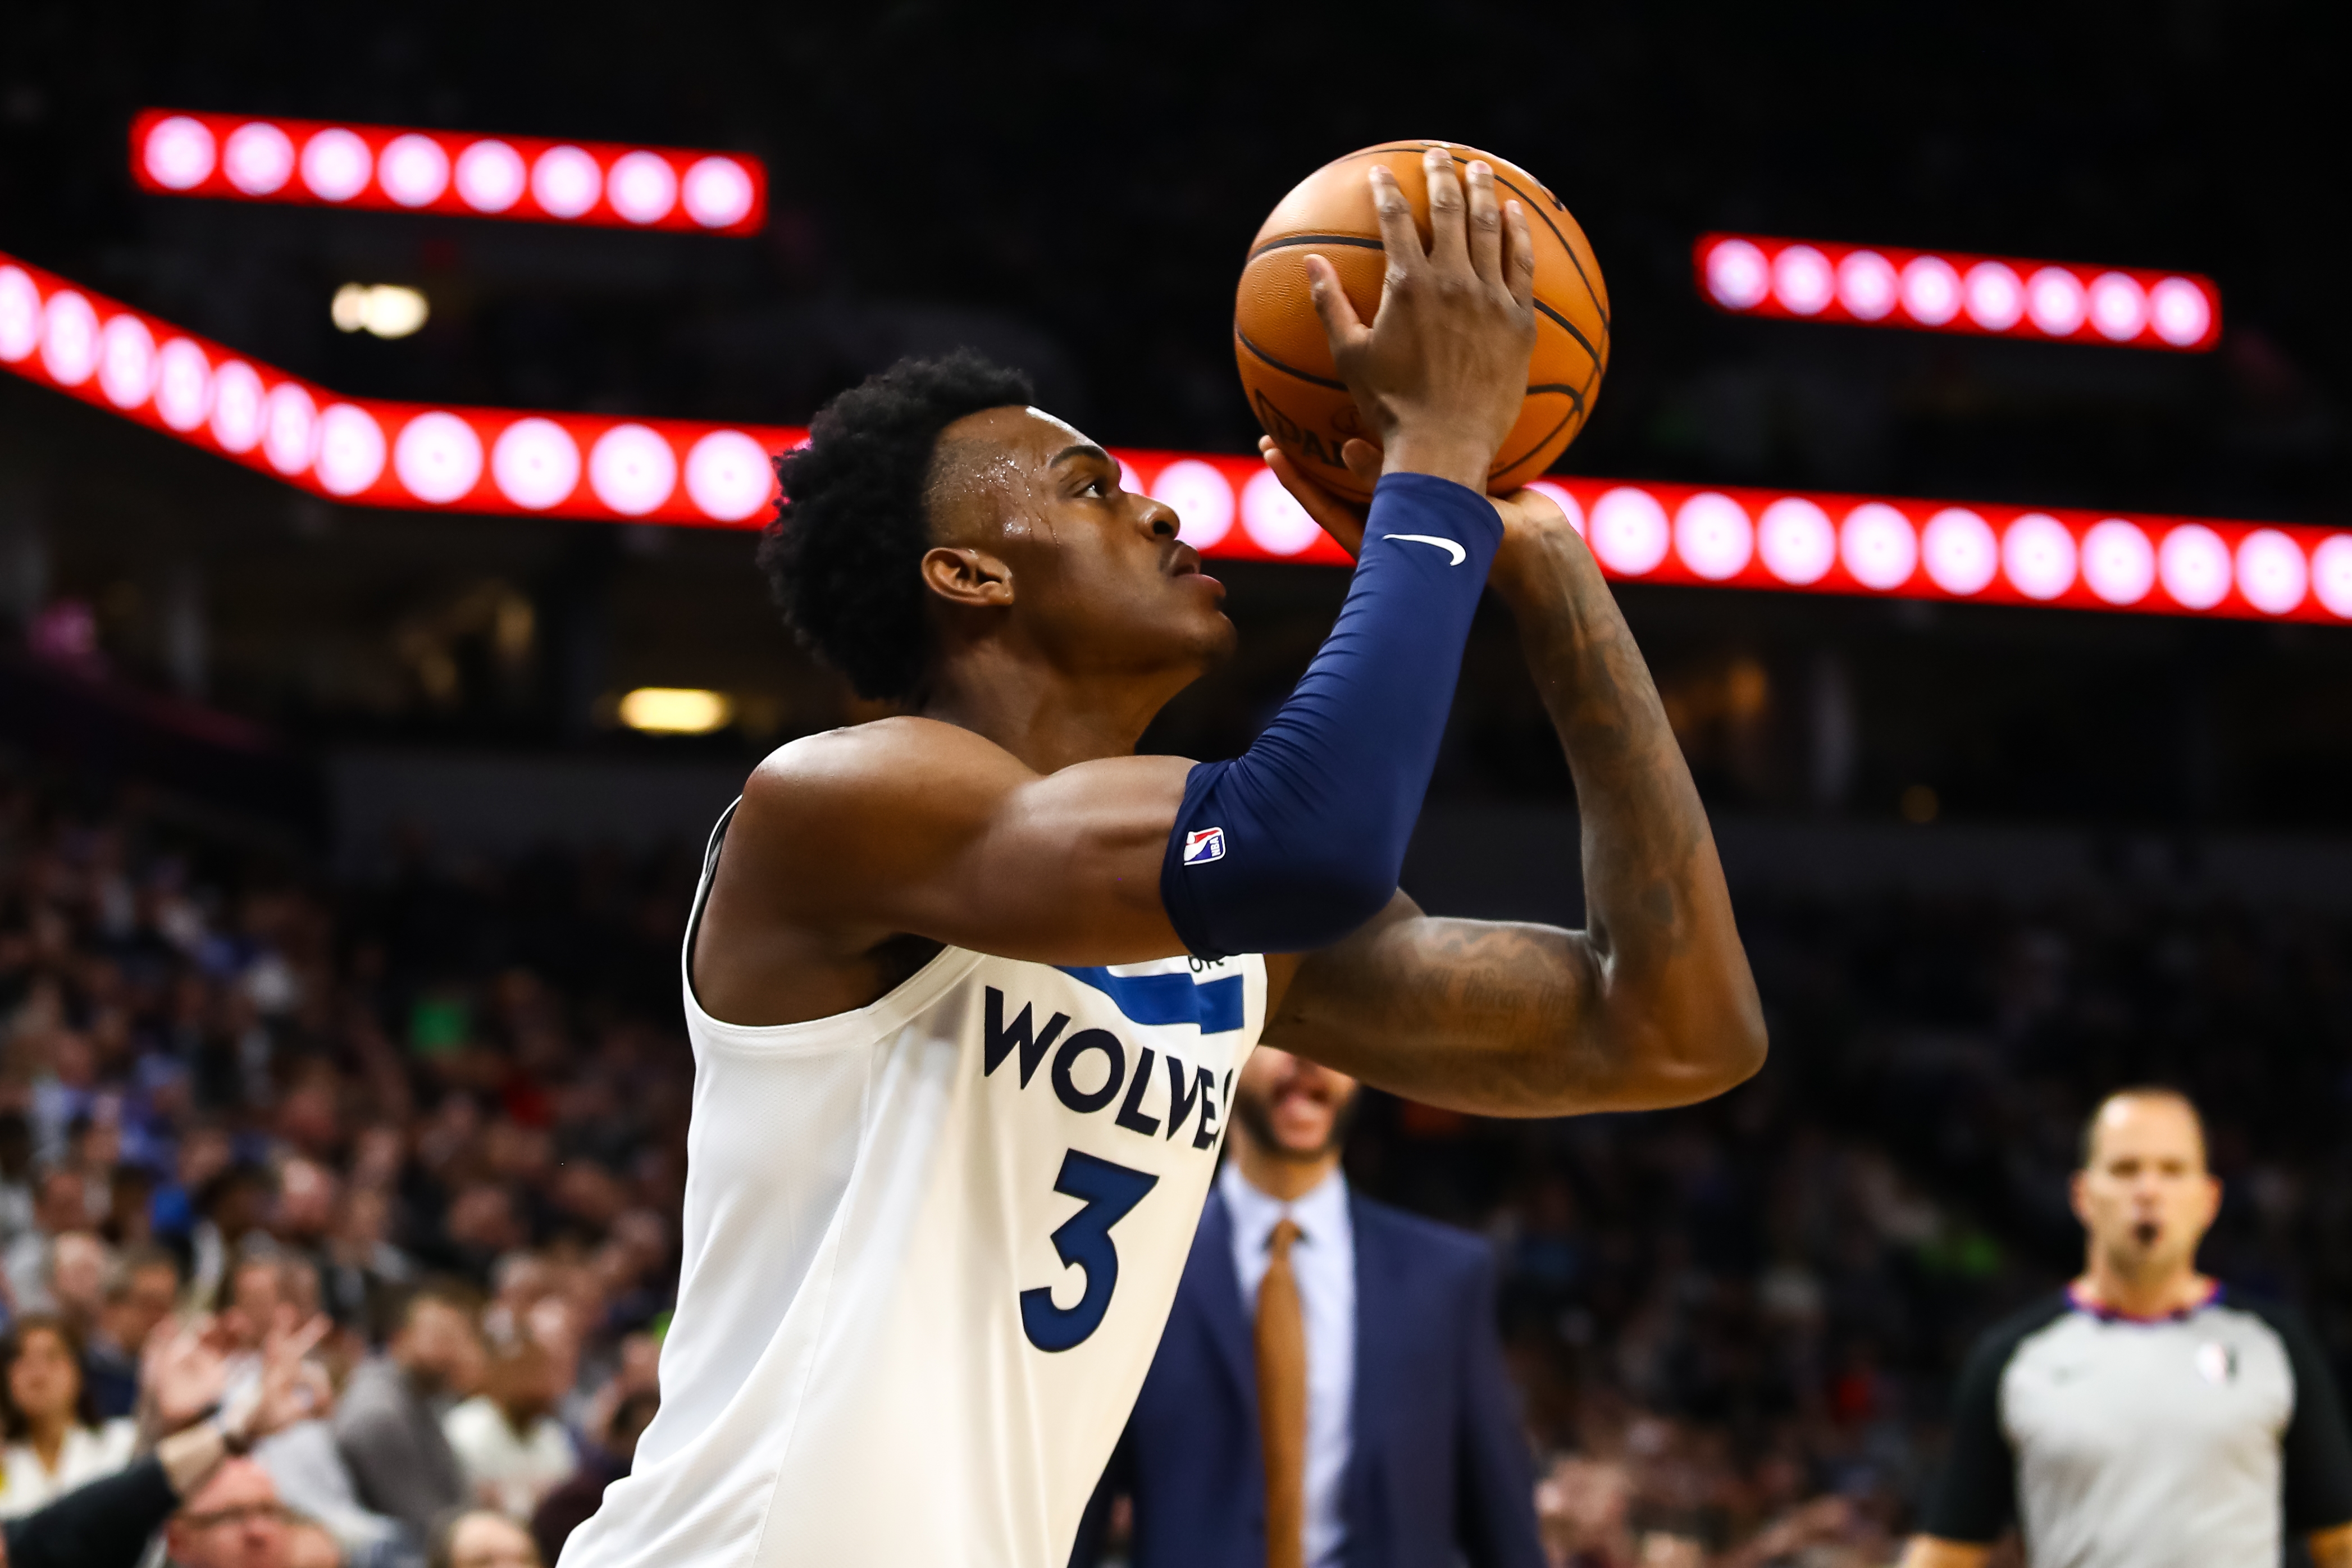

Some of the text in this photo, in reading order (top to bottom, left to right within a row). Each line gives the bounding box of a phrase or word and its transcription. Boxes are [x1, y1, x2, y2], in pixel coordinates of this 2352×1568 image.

[1209, 836, 1221, 857] NBA
[984, 986, 1233, 1150] WOLVE
[1019, 1148, 1160, 1353] 3
